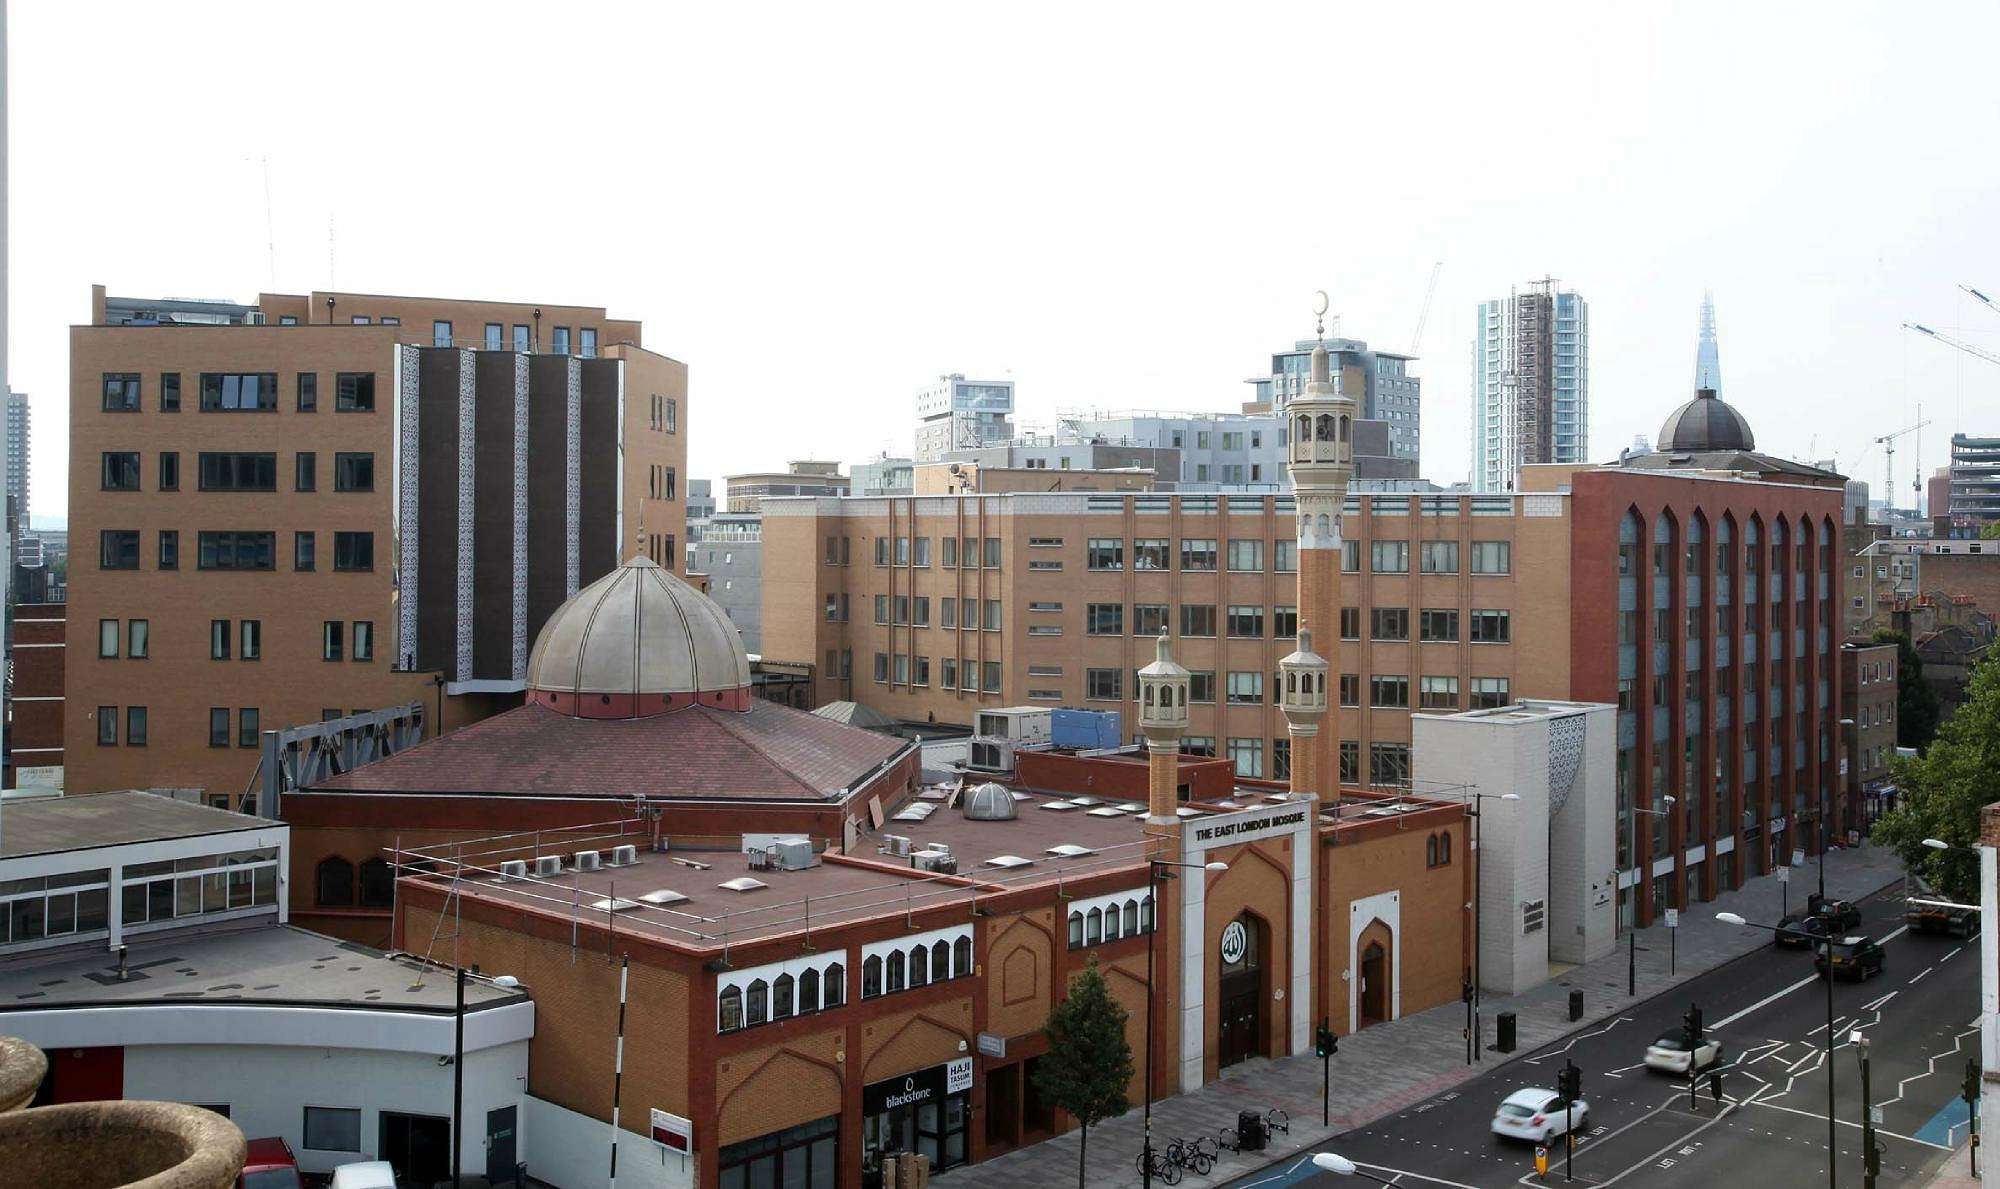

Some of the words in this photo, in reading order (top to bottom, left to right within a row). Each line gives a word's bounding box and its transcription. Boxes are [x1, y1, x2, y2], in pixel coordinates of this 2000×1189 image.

[1196, 826, 1212, 841] THE
[1214, 823, 1236, 838] EAST
[1237, 818, 1271, 834] LONDON
[1272, 811, 1305, 828] MOSQUE
[950, 1062, 970, 1076] HAJI
[886, 1087, 932, 1109] blackstone
